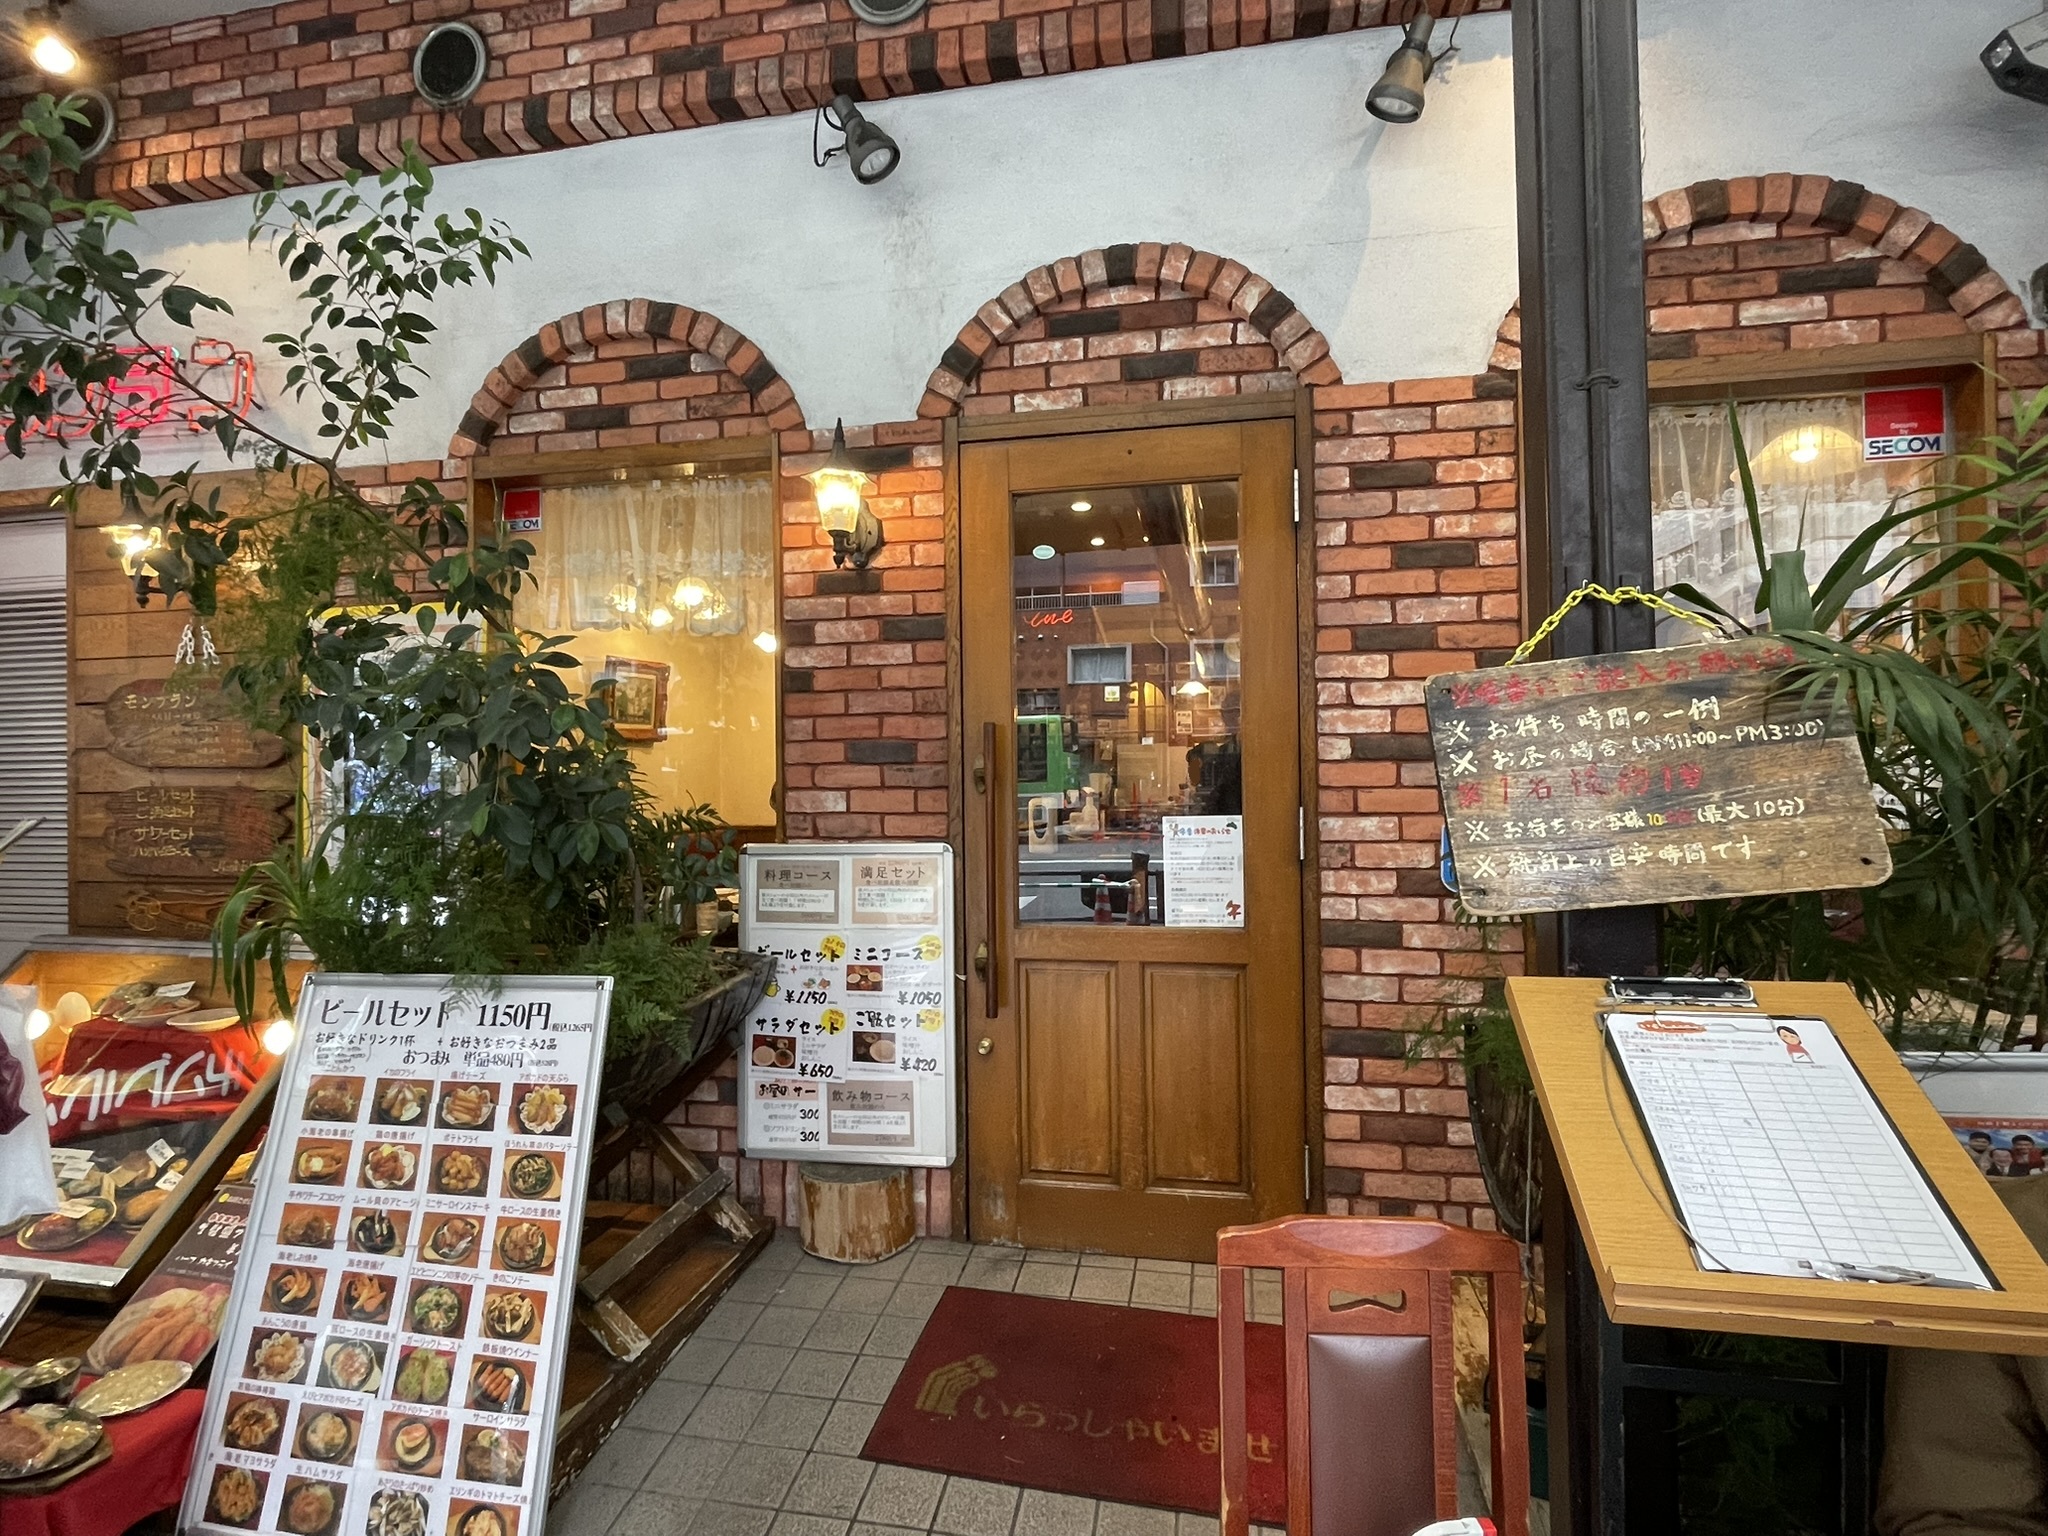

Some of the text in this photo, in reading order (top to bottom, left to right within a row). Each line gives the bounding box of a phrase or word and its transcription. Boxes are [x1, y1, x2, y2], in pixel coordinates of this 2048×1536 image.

[1869, 436, 1941, 455] SECOM
[764, 869, 832, 882] 料理コース
[860, 866, 925, 879] 満足セット
[757, 944, 840, 963] ビールセット
[854, 947, 923, 961] ミニコース
[785, 989, 827, 1005] ¥1150
[897, 990, 942, 1005] ¥1050
[321, 999, 449, 1028] ビールセット
[476, 1002, 551, 1030] 1150円
[856, 1010, 926, 1029] ご飯セット
[756, 1017, 839, 1035] サラダセット
[403, 1049, 450, 1066] おつまみ
[464, 1051, 524, 1068] 単品480円
[900, 1056, 937, 1072] ¥420
[798, 1062, 834, 1078] ¥650
[832, 1090, 911, 1102] 飲み物コース
[444, 1134, 479, 1144] ポテトフライ
